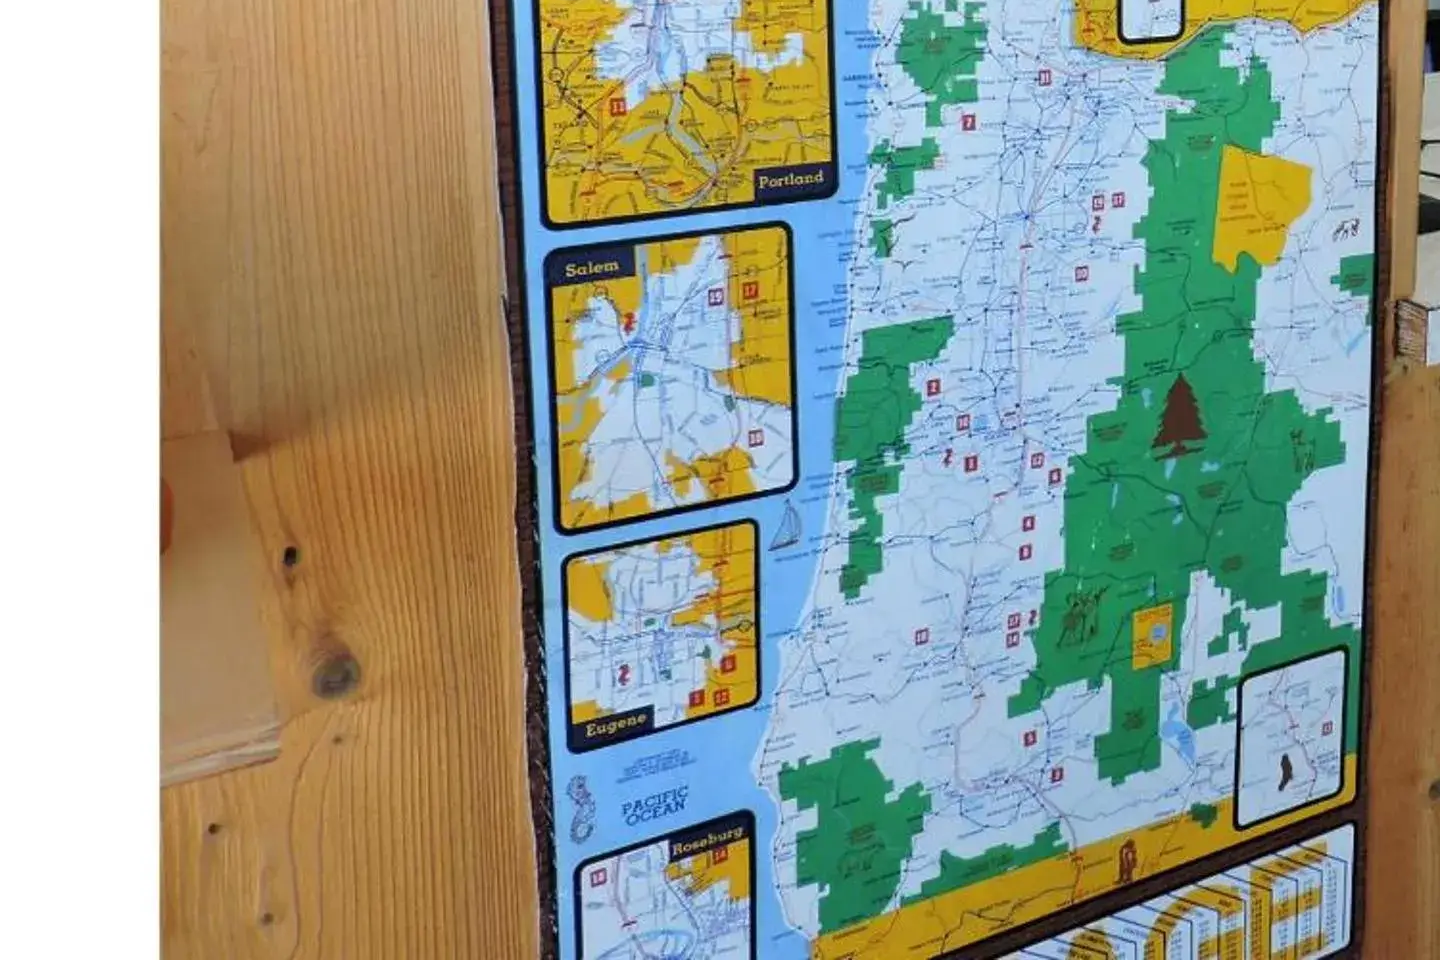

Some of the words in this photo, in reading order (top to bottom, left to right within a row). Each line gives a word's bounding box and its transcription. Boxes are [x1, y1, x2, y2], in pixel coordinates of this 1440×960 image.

[758, 169, 825, 189] Portland
[565, 261, 620, 278] Salem
[585, 713, 647, 738] Eugene
[620, 785, 689, 816] PACIFIC
[625, 797, 687, 827] OCEAN
[673, 827, 744, 856] Roseburg
